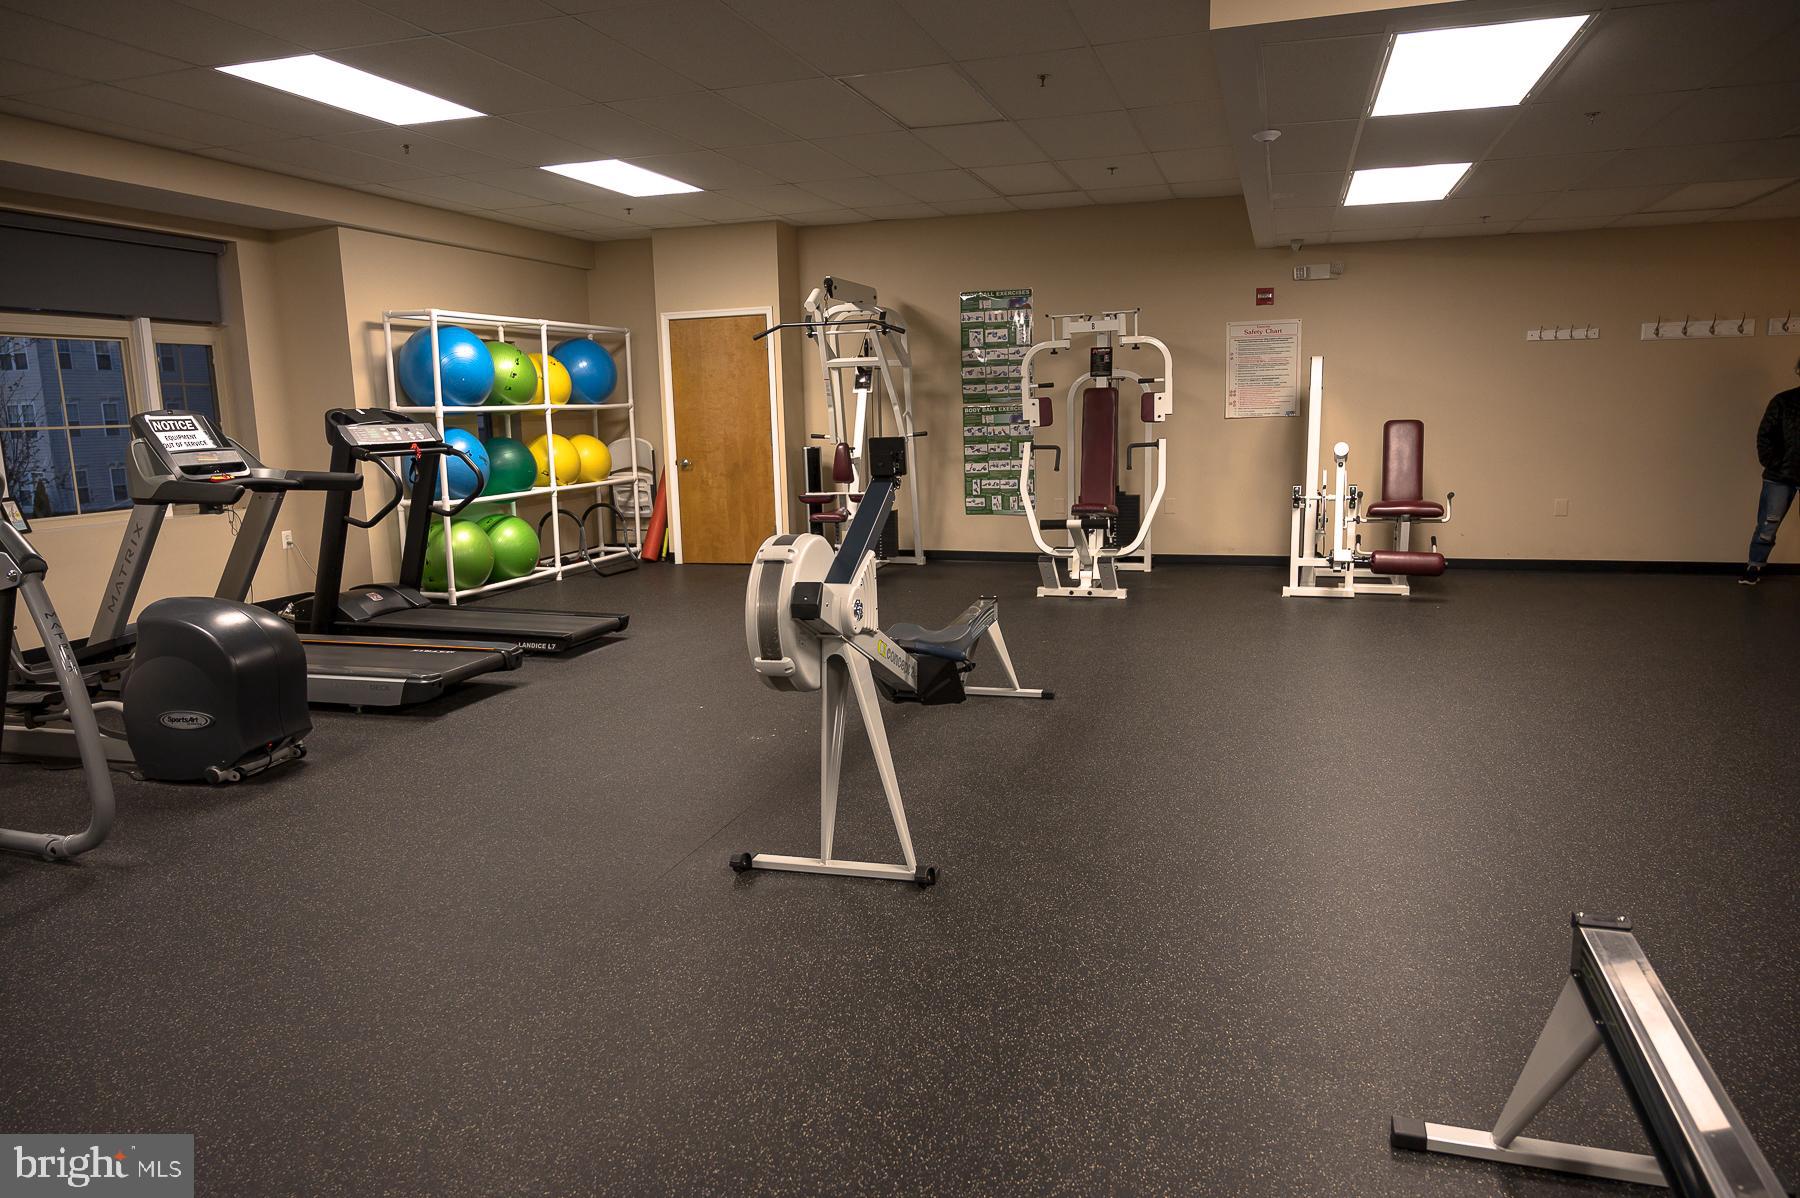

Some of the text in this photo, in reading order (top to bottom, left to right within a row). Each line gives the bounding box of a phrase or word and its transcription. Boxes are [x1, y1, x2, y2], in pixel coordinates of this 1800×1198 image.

[1243, 327, 1283, 336] Safety Chart
[151, 420, 195, 431] NOTICE
[107, 523, 144, 613] MATRIX
[167, 715, 199, 725] SportsArt
